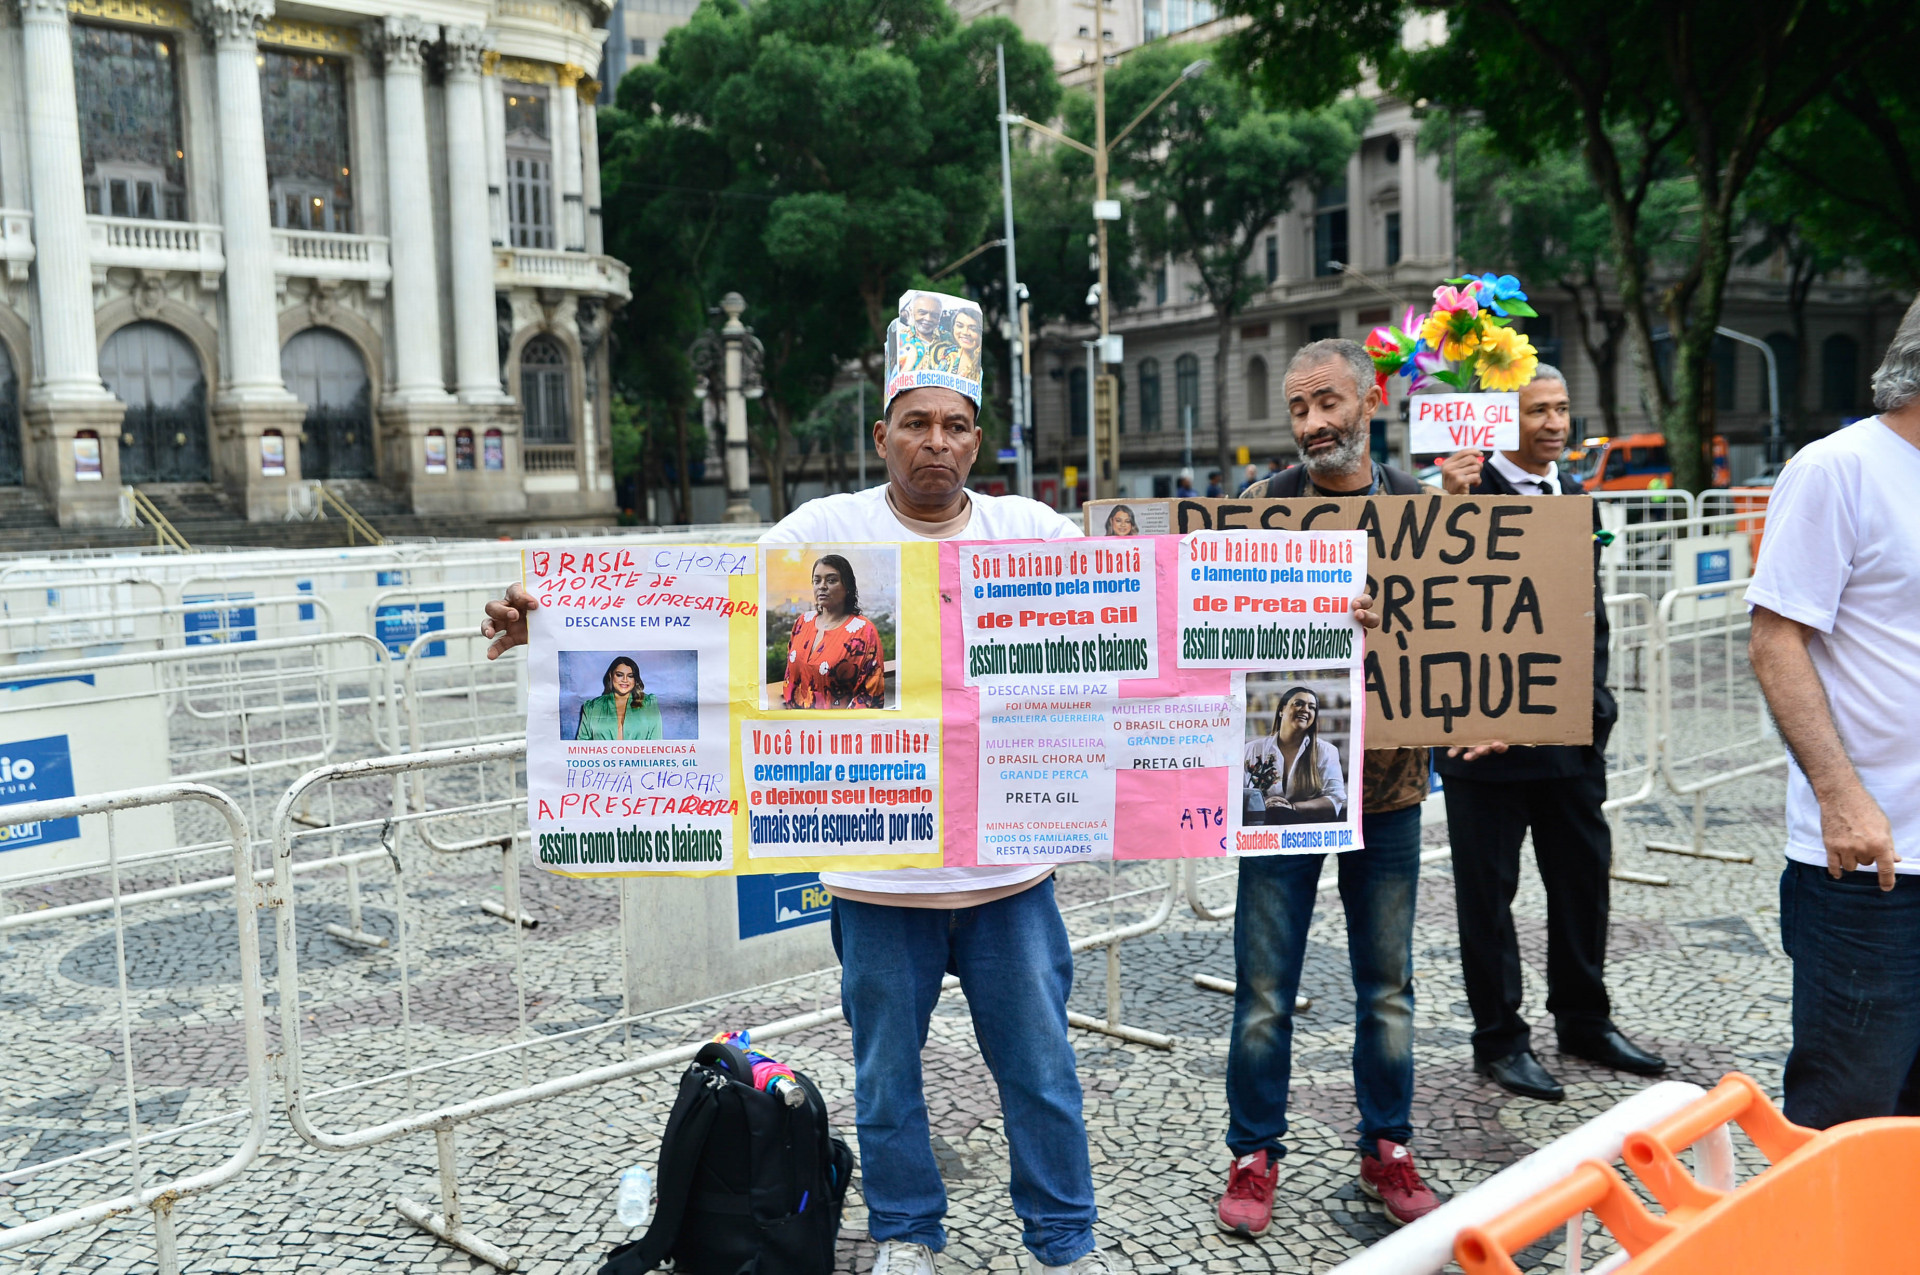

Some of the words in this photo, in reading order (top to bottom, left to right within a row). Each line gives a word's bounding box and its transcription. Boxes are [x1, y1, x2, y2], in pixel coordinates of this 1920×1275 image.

[917, 372, 954, 388] descanse
[956, 378, 966, 392] em
[968, 381, 979, 396] paz
[1420, 401, 1475, 422] PRETA
[1484, 405, 1513, 423] GIL
[1449, 425, 1494, 446] VIVE
[1191, 537, 1217, 562] Sou
[1226, 538, 1277, 562] baiano
[1286, 539, 1302, 563] de
[1310, 539, 1352, 563] Ubatã
[656, 551, 747, 576] CHORA
[973, 554, 1000, 579] Sou
[1008, 553, 1062, 578] baiano
[1070, 551, 1087, 574] de
[1096, 547, 1140, 574] Ubatã
[538, 571, 642, 592] MORTE
[1191, 568, 1200, 581] e
[1204, 566, 1267, 582] lamento
[1271, 567, 1303, 583] pela
[1307, 568, 1352, 583] morte
[974, 585, 984, 598] e
[988, 582, 1050, 598] lamento
[1056, 579, 1089, 596] pela
[1093, 578, 1140, 593] morte
[1193, 596, 1228, 611] de
[1235, 596, 1306, 612] Preta
[1313, 597, 1348, 613] Gil
[1366, 576, 1543, 634] RETA
[565, 617, 635, 627] DESCANSE
[640, 617, 660, 627] EM
[665, 616, 690, 627] PAZ
[978, 612, 1013, 629] de
[1020, 610, 1094, 627] Preta
[1101, 606, 1137, 624] Gil
[1184, 621, 1219, 659] assim
[1222, 627, 1254, 660] como
[1257, 622, 1290, 659] todos
[1292, 628, 1305, 659] os
[1308, 622, 1353, 659] baianos
[970, 638, 1007, 677] assim
[1009, 642, 1043, 674] como
[1045, 635, 1080, 673] todos
[1082, 640, 1096, 672] os
[1099, 633, 1147, 671] baianos
[988, 685, 1055, 696] DESCANSE
[1060, 685, 1078, 695] EM
[1083, 684, 1107, 694] PAZ
[1006, 702, 1022, 710] FOI
[1025, 702, 1048, 710] UMA
[1050, 701, 1091, 709] MULHER
[1112, 705, 1161, 715] MULHER
[1165, 702, 1231, 714] BRASILEIRA,
[992, 715, 1048, 724] BRASILEIRA
[1050, 714, 1104, 722] GUERREIRA
[1113, 721, 1121, 730] O
[1126, 720, 1165, 730] BRASIL
[1169, 719, 1208, 729] CHORA
[1212, 718, 1230, 727] UM
[611, 746, 685, 754] CONDELENCIAS
[689, 744, 696, 753] Á
[753, 729, 792, 755] Você
[800, 730, 821, 754] foi
[831, 733, 862, 754] uma
[871, 730, 929, 754] mulher
[986, 738, 1036, 749] MULHER
[1128, 736, 1175, 746] GRANDE
[1179, 735, 1213, 745] PERCA
[566, 760, 600, 768] TODOS
[603, 759, 615, 768] OS
[619, 759, 679, 768] FAMILIARES,
[987, 755, 995, 765] O
[999, 754, 1038, 764] BRASIL
[1042, 754, 1083, 763] CHORA
[1087, 753, 1106, 763] UM
[1133, 758, 1177, 769] PRETA
[1183, 757, 1205, 768] GIL
[0, 757, 35, 783] io
[754, 761, 832, 783] exemplar
[835, 764, 845, 781] e
[849, 761, 925, 783] guerreira
[1000, 770, 1048, 780] GRANDE
[1053, 770, 1088, 780] PERCA
[751, 790, 762, 805] e
[766, 788, 827, 804] deixou
[832, 789, 864, 804] seu
[869, 787, 932, 806] legado
[1006, 793, 1051, 803] PRETA
[1056, 792, 1079, 803] GIL
[792, 807, 819, 843] será
[822, 808, 884, 846] esquecida
[889, 813, 909, 844] por
[912, 806, 933, 840] nós
[986, 822, 1024, 830] MINHAS
[1027, 821, 1098, 830] CONDELENCIAS
[539, 827, 578, 864] assim
[580, 834, 614, 863] como
[617, 825, 650, 863] todos
[655, 832, 669, 862] os
[672, 823, 722, 862] baianos
[985, 835, 1016, 843] TODOS
[1019, 835, 1031, 843] OS
[1034, 834, 1090, 843] FAMILIARES,
[1094, 832, 1108, 841] GIL
[1236, 830, 1280, 851] Saudades,
[1281, 830, 1322, 849] descanse
[1324, 833, 1337, 847] em
[1339, 830, 1352, 848] paz
[996, 846, 1030, 855] RESTA
[1033, 845, 1091, 855] SAUDADES
